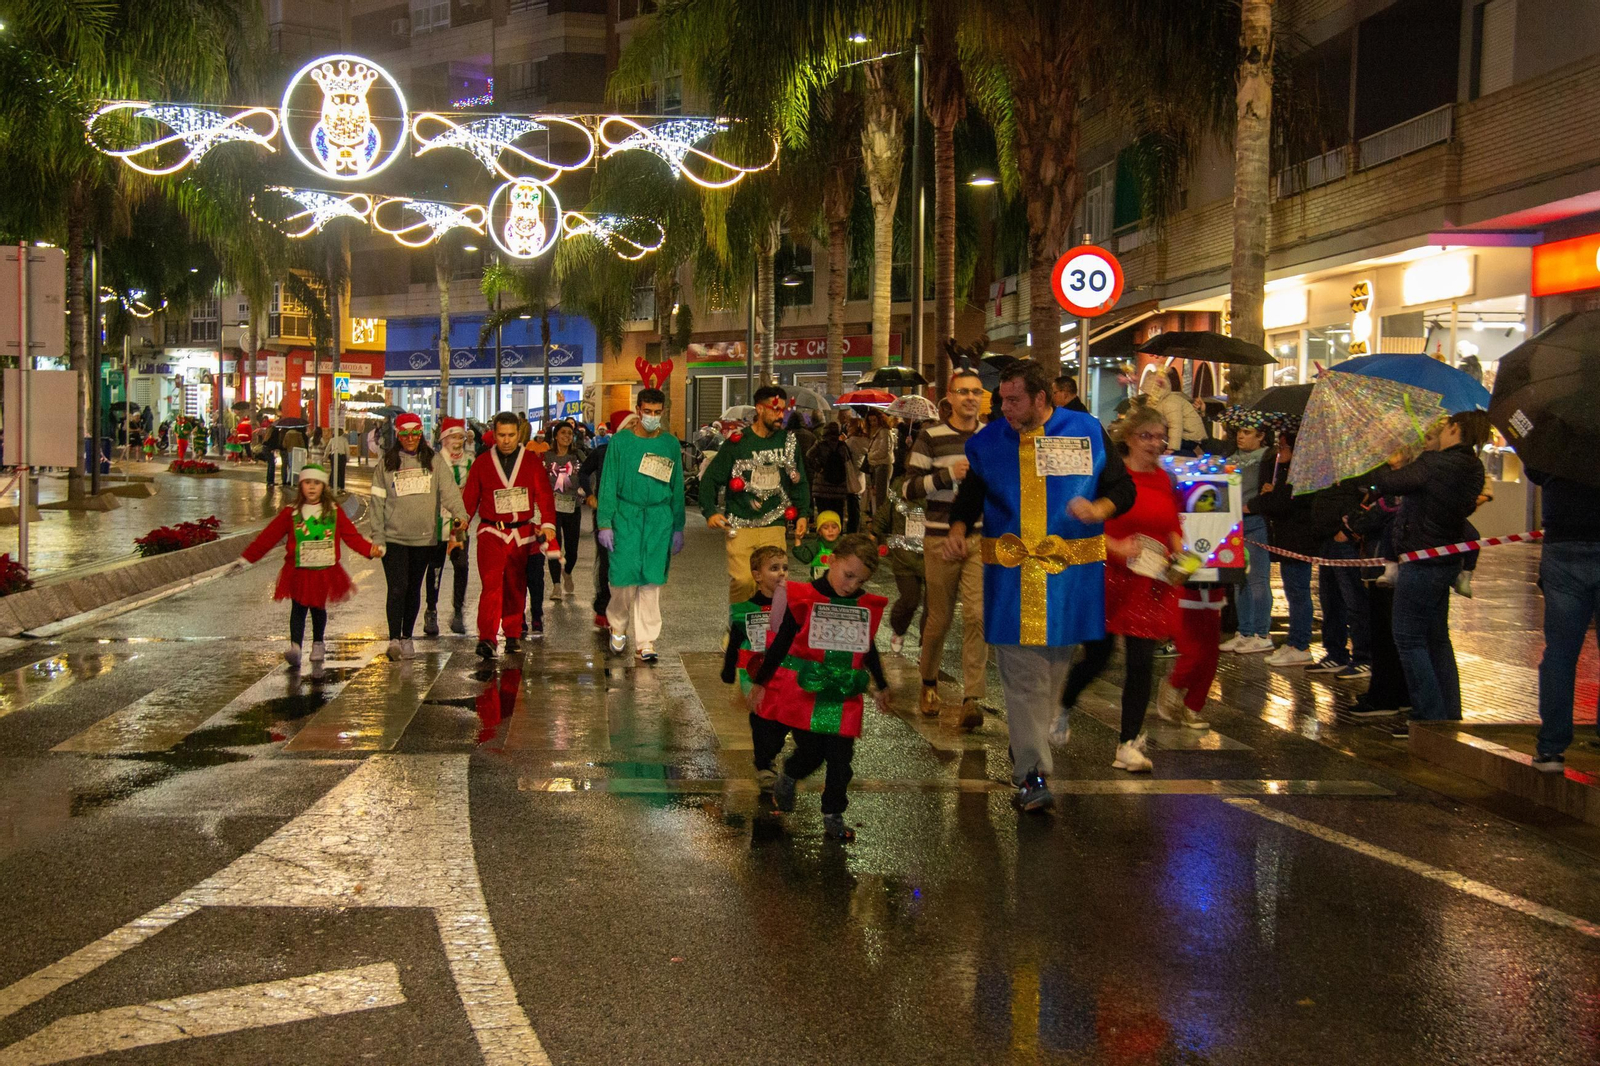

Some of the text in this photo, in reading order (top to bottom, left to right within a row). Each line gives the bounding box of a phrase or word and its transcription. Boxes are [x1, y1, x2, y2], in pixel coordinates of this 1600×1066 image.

[1069, 269, 1107, 292] 30
[727, 338, 850, 358] EL CRTE CHO
[342, 363, 363, 371] MODA
[1046, 454, 1082, 469] 528
[831, 606, 859, 614] SILVESTRE
[821, 624, 858, 643] 529
